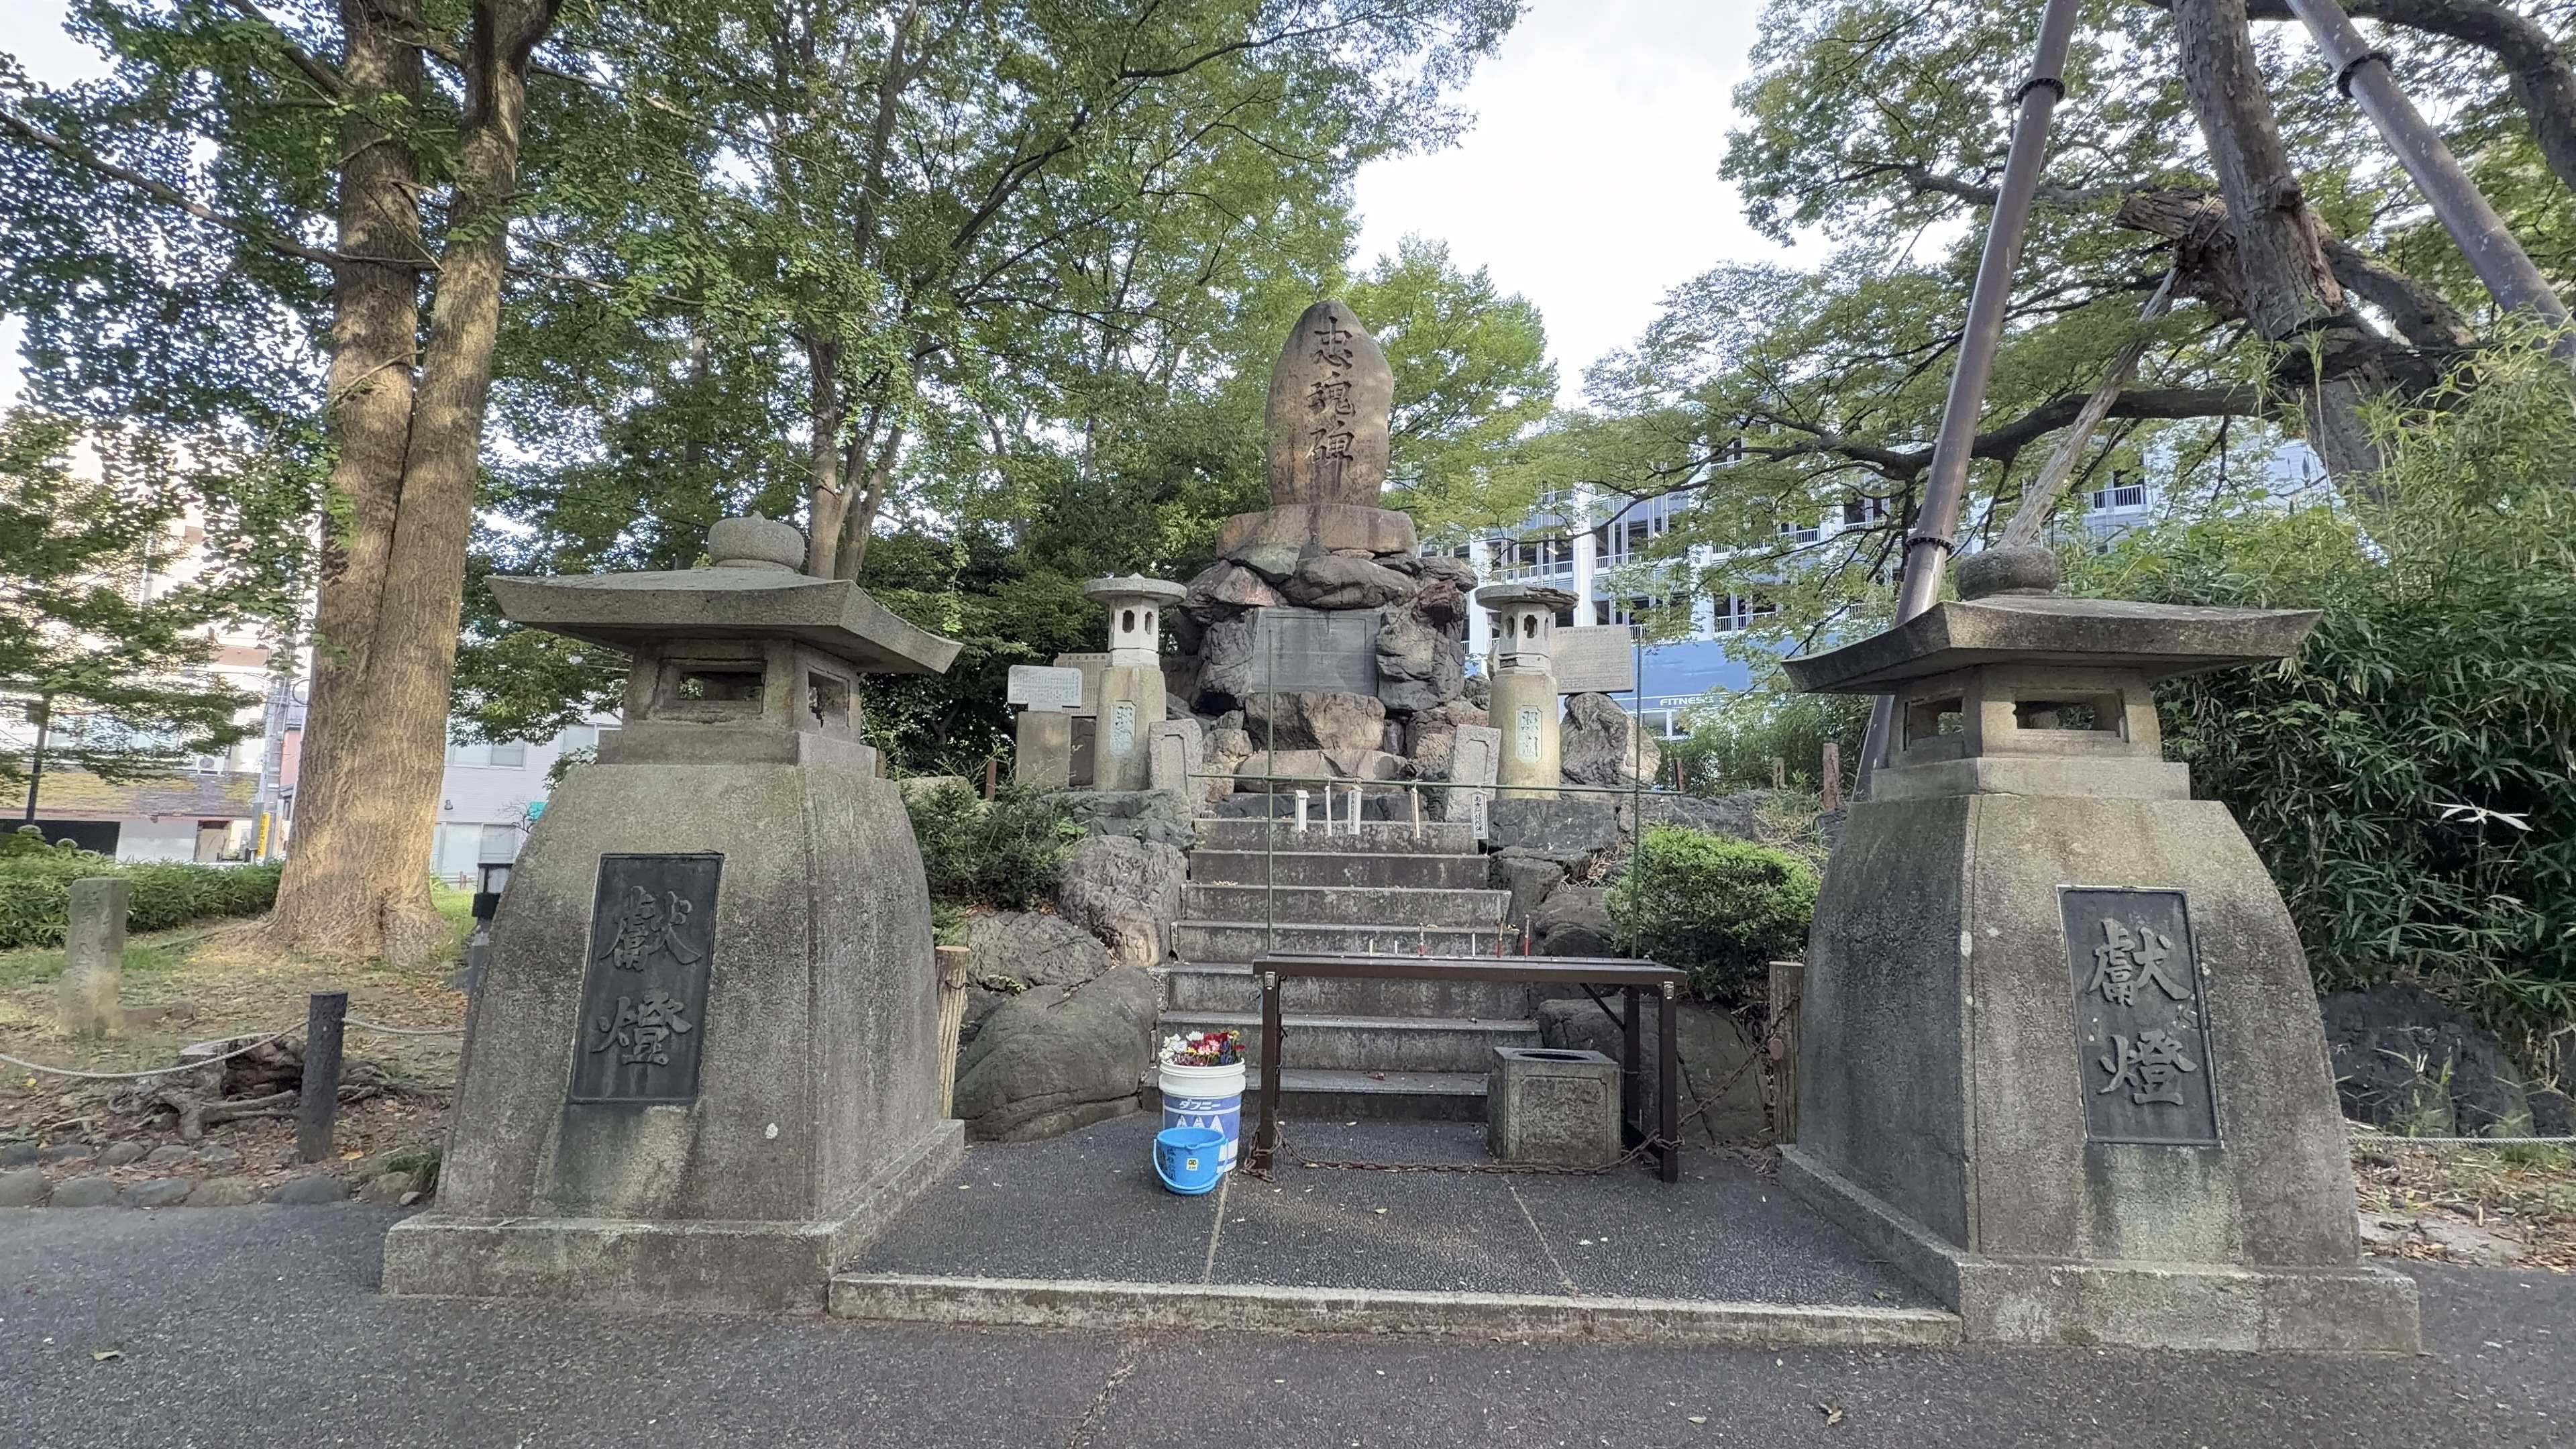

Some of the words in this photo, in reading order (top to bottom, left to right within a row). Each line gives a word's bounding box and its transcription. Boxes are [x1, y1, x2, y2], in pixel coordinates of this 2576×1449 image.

[1305, 315, 1356, 488] 忠魂碑
[1179, 1098, 1221, 1111] ダフニー
